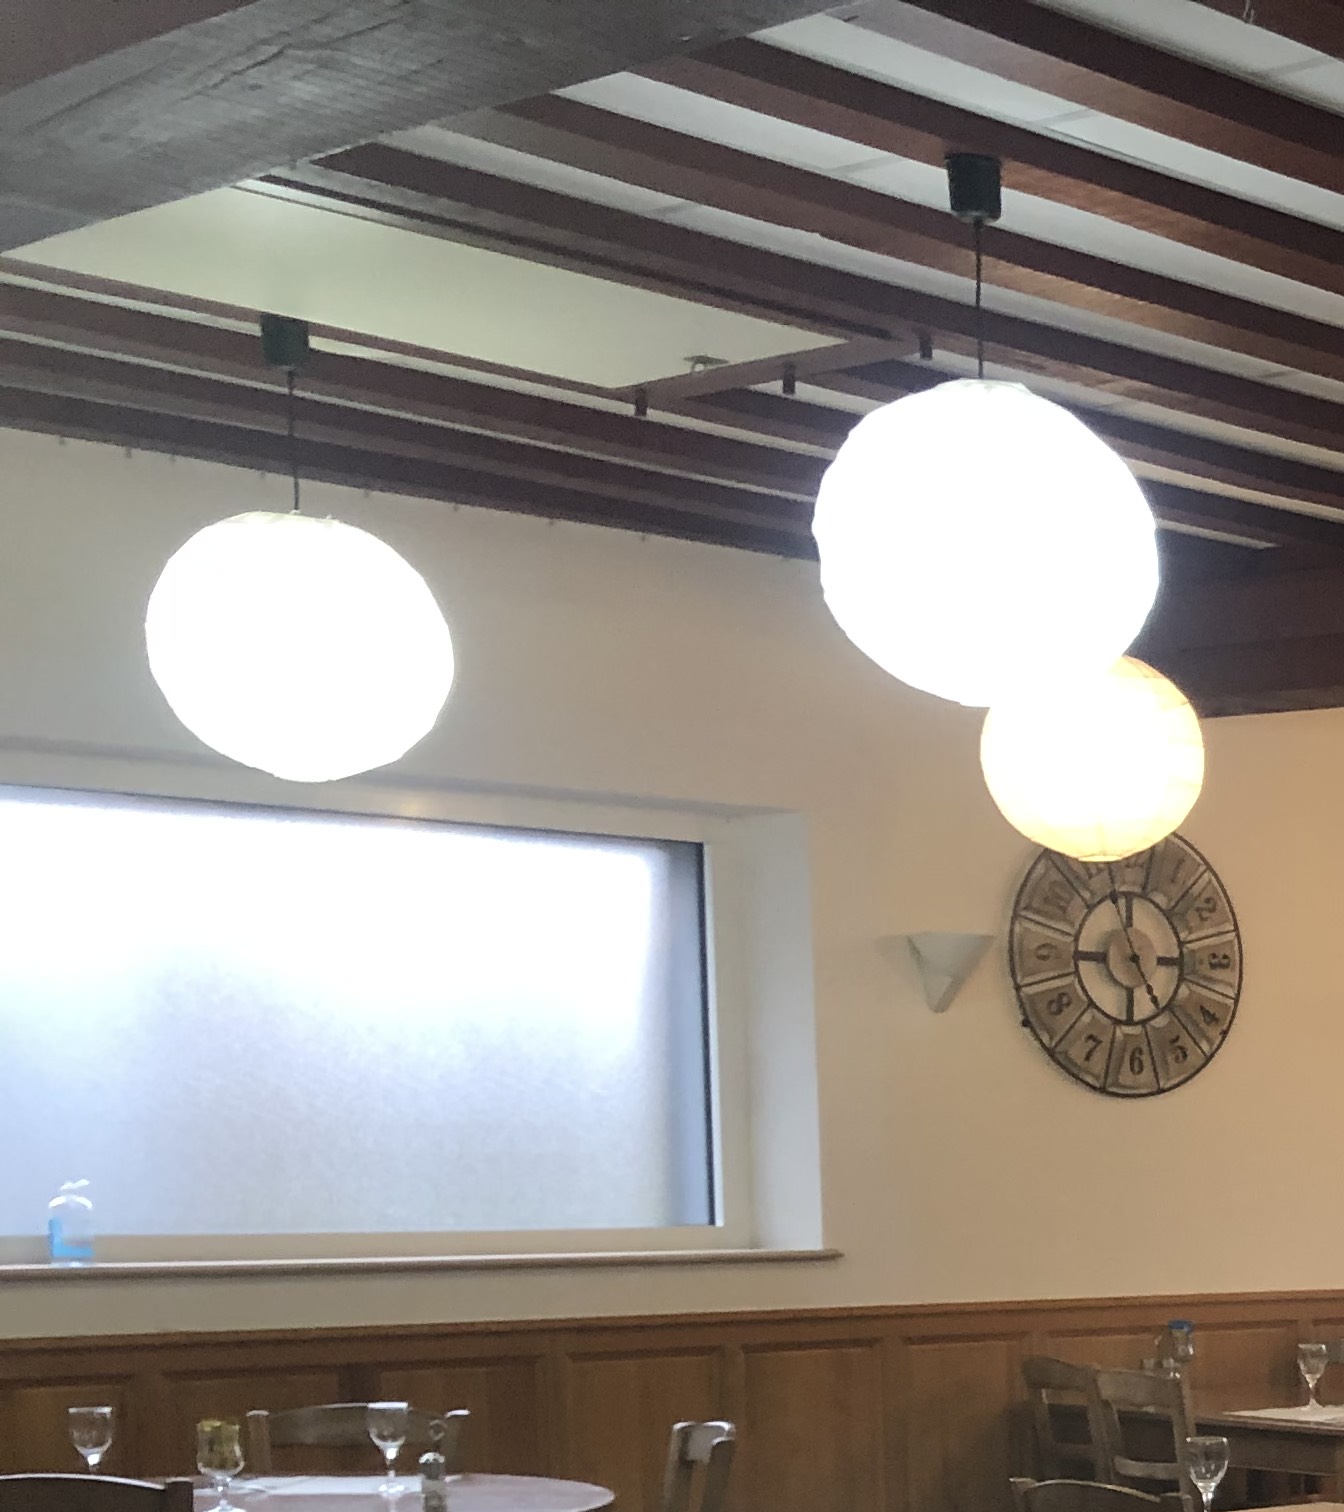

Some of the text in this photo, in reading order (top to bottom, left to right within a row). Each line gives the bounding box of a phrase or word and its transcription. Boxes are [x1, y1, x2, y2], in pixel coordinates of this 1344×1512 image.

[1194, 896, 1218, 922] 2
[1208, 952, 1231, 970] 3
[1046, 991, 1071, 1016] 8
[1198, 1004, 1219, 1026] 4
[1082, 1033, 1103, 1063] 7
[1169, 1035, 1188, 1064] 5
[1128, 1047, 1144, 1076] 6
